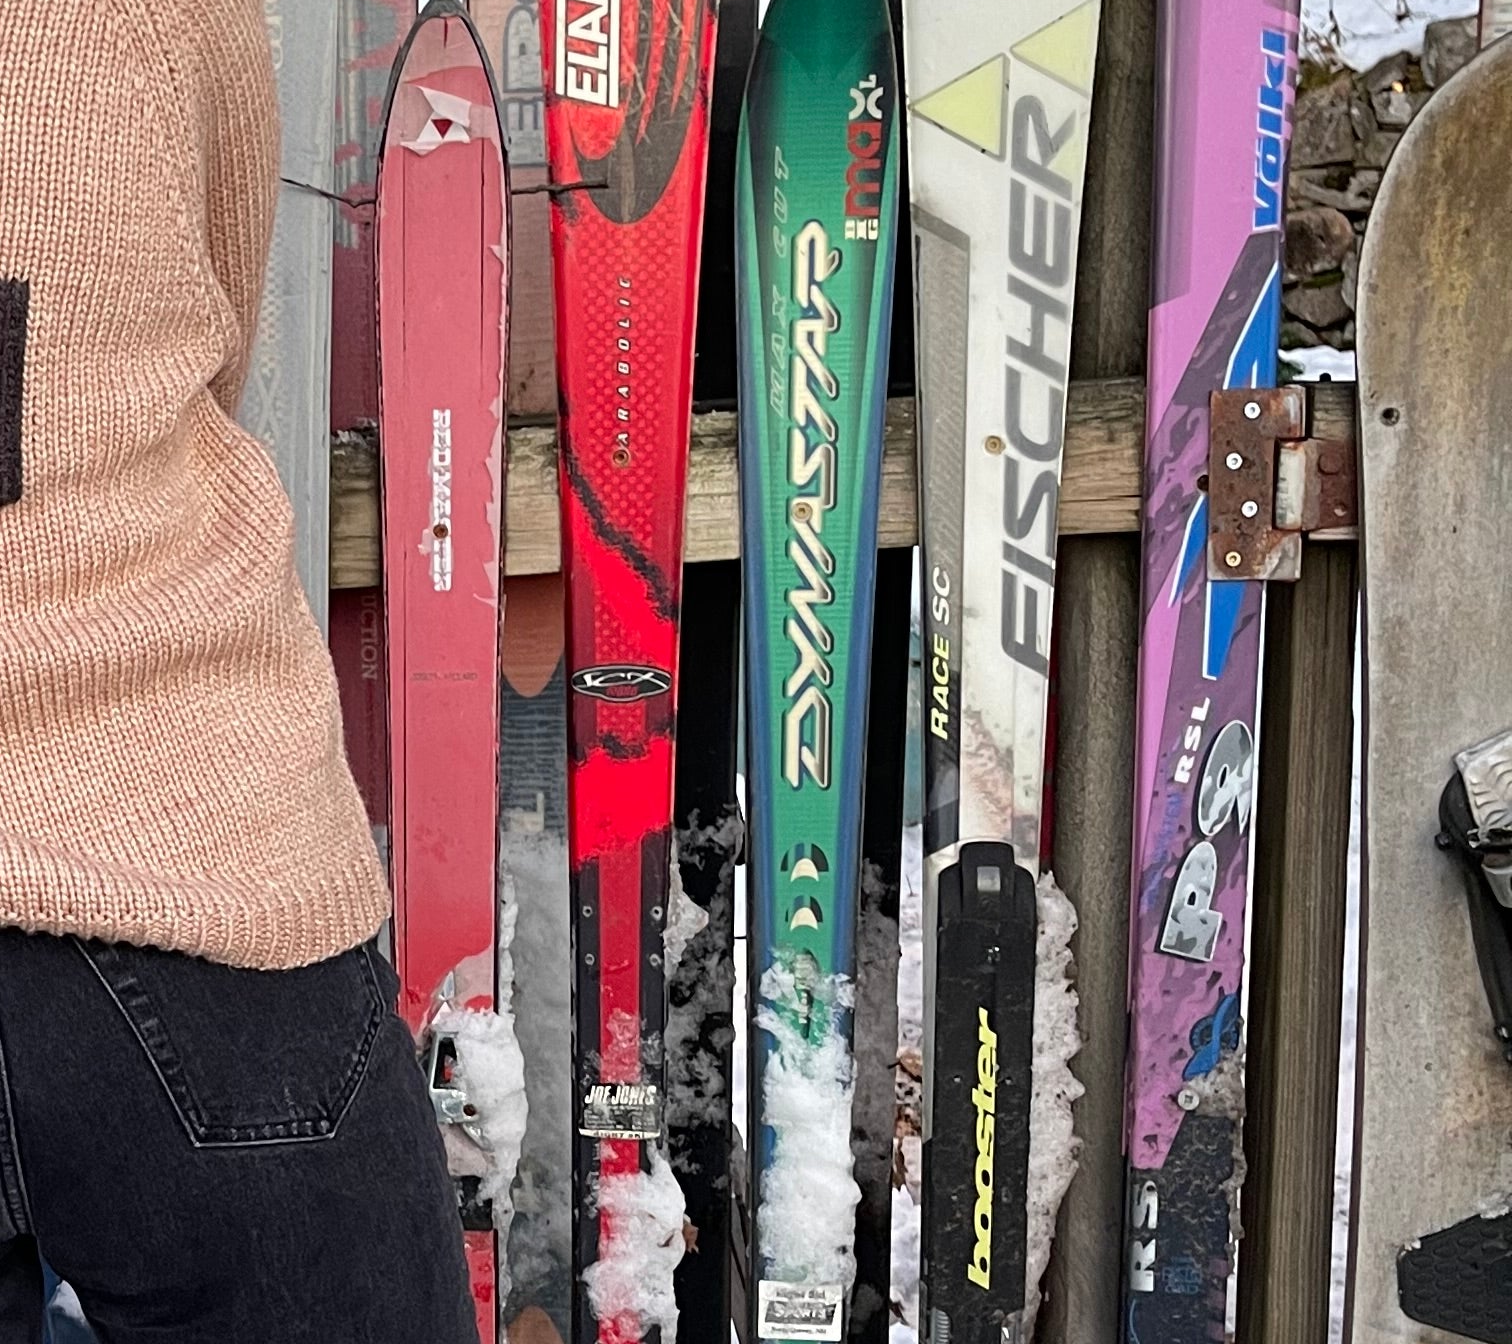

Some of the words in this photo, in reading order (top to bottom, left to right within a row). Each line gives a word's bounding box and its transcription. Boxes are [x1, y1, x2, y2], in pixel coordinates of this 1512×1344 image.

[772, 145, 790, 259] CUT
[615, 276, 632, 456] ARABOLIC
[769, 285, 787, 418] MAX
[1001, 92, 1079, 681] FISCHER
[782, 220, 842, 790] DYNASTAR
[360, 593, 379, 682] UCTION
[931, 565, 952, 630] SC
[929, 644, 953, 740] RACE
[1175, 696, 1213, 785] RSL
[584, 1085, 611, 1104] JOE
[966, 1007, 999, 1290] booster
